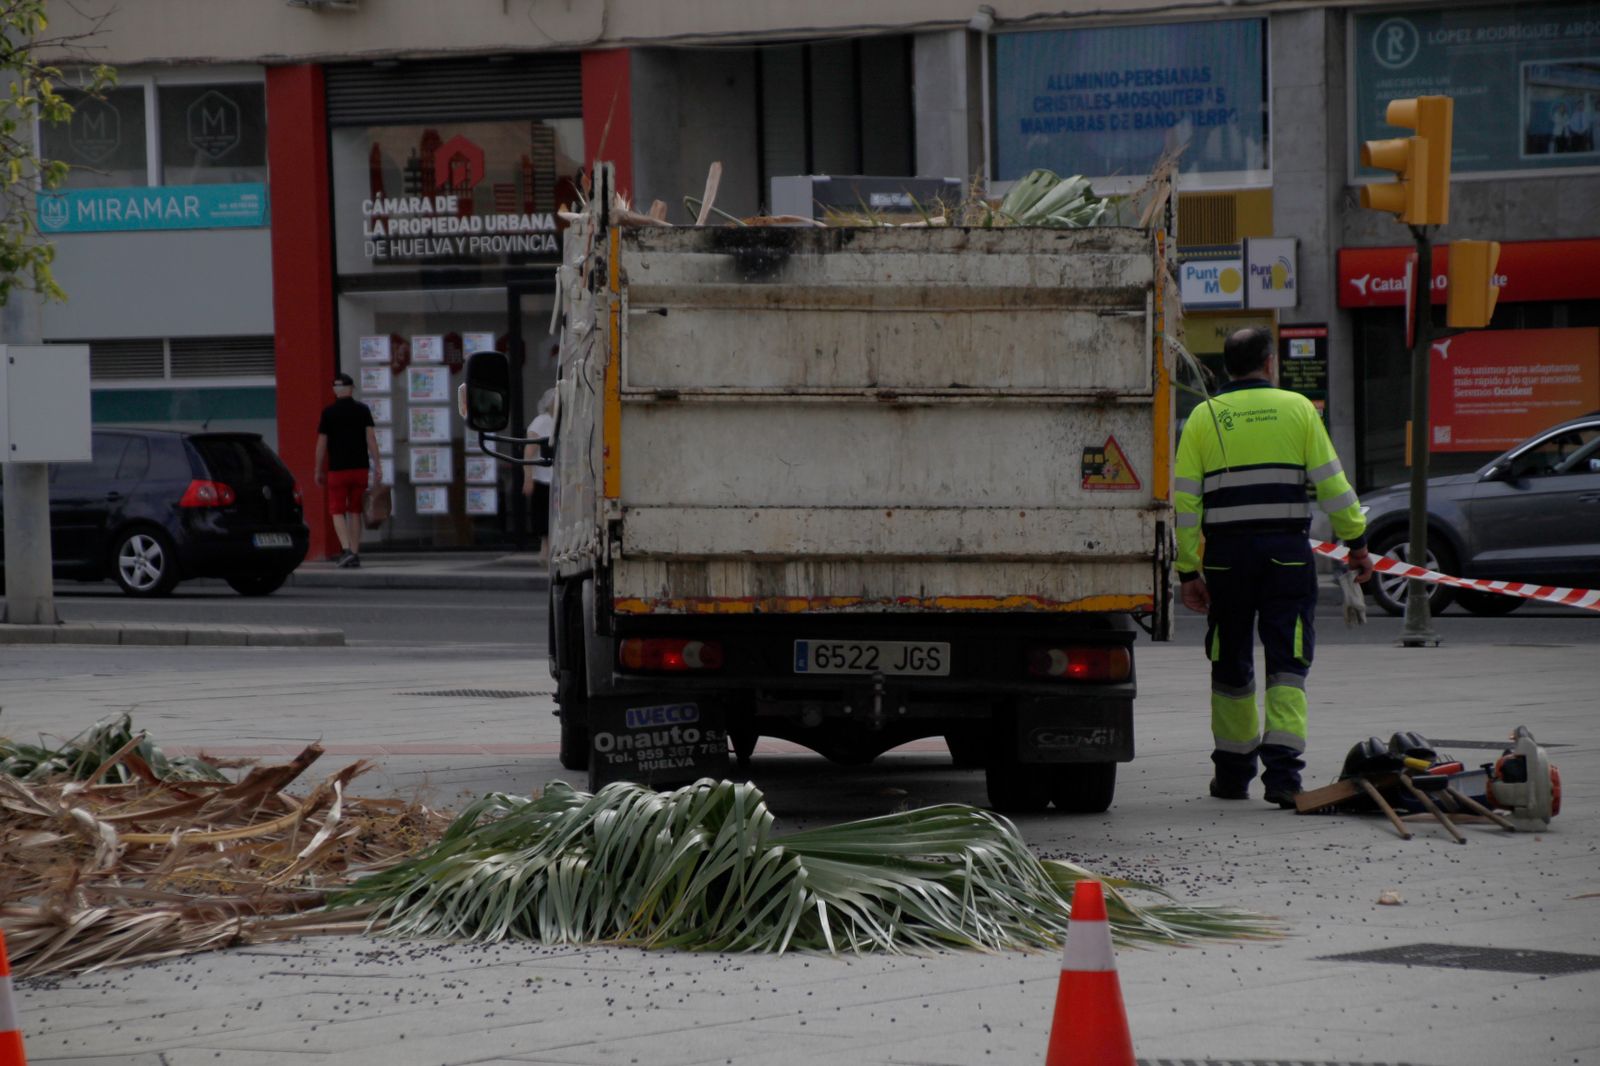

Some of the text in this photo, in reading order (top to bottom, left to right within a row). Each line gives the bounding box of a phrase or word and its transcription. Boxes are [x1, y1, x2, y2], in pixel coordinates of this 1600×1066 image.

[1047, 67, 1211, 91] ALUMINIO-PERSIANAS
[202, 106, 225, 136] M
[1020, 115, 1105, 134] MAMPARAS
[1110, 113, 1129, 131] DE
[77, 195, 200, 222] MIRAMAR
[362, 191, 459, 215] CÁMARA DE
[363, 213, 556, 237] LA PROPIEDAD URBANA
[364, 234, 558, 257] DE HUELVA Y PROVINCIA
[1233, 408, 1277, 418] Ayuntamiento
[815, 644, 941, 671] 6522 JGS
[626, 704, 699, 726] IVECO
[594, 726, 701, 752] Onauto
[605, 752, 633, 764] Tel.
[637, 748, 664, 760] 959
[638, 757, 695, 771] HUELVA
